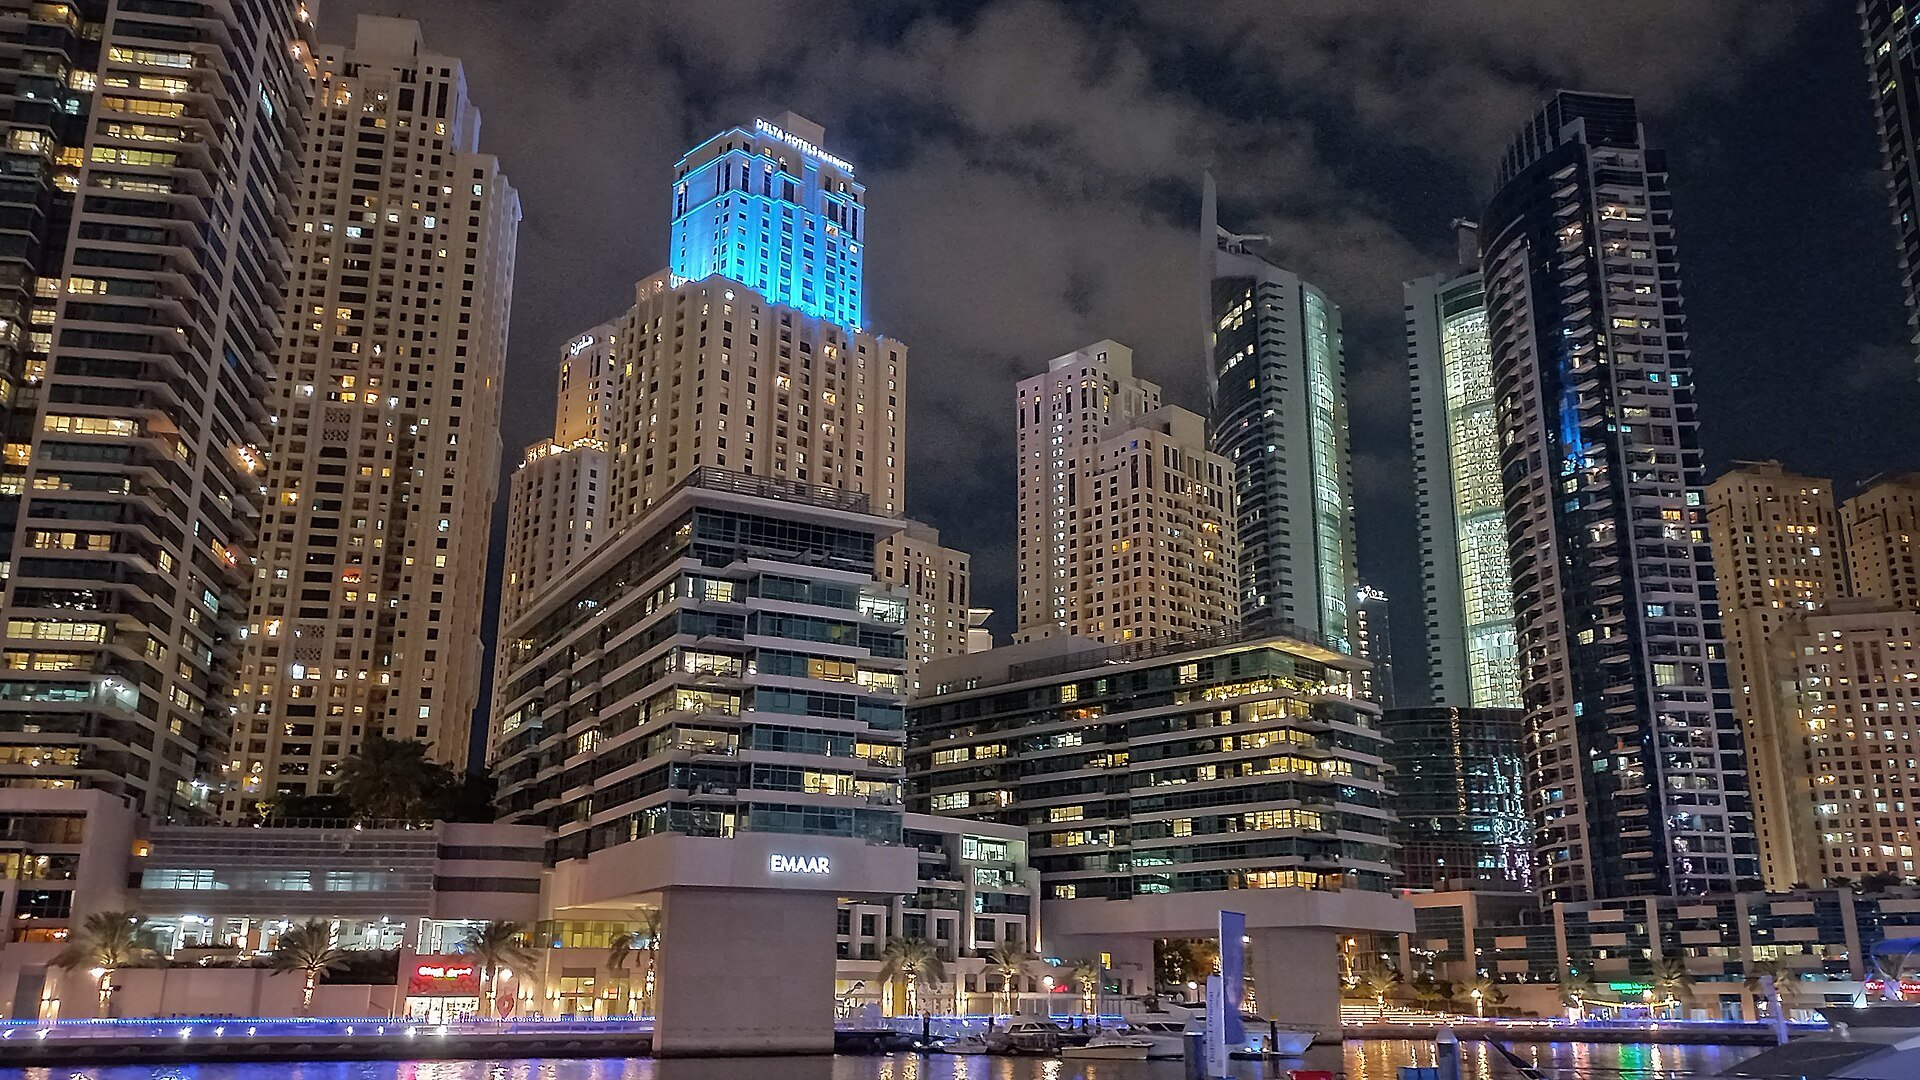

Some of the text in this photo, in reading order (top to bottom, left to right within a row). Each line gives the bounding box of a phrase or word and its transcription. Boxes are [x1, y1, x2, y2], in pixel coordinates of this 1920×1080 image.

[756, 118, 784, 141] DELTA
[784, 132, 818, 156] HOTELS
[770, 854, 831, 874] EMAAR
